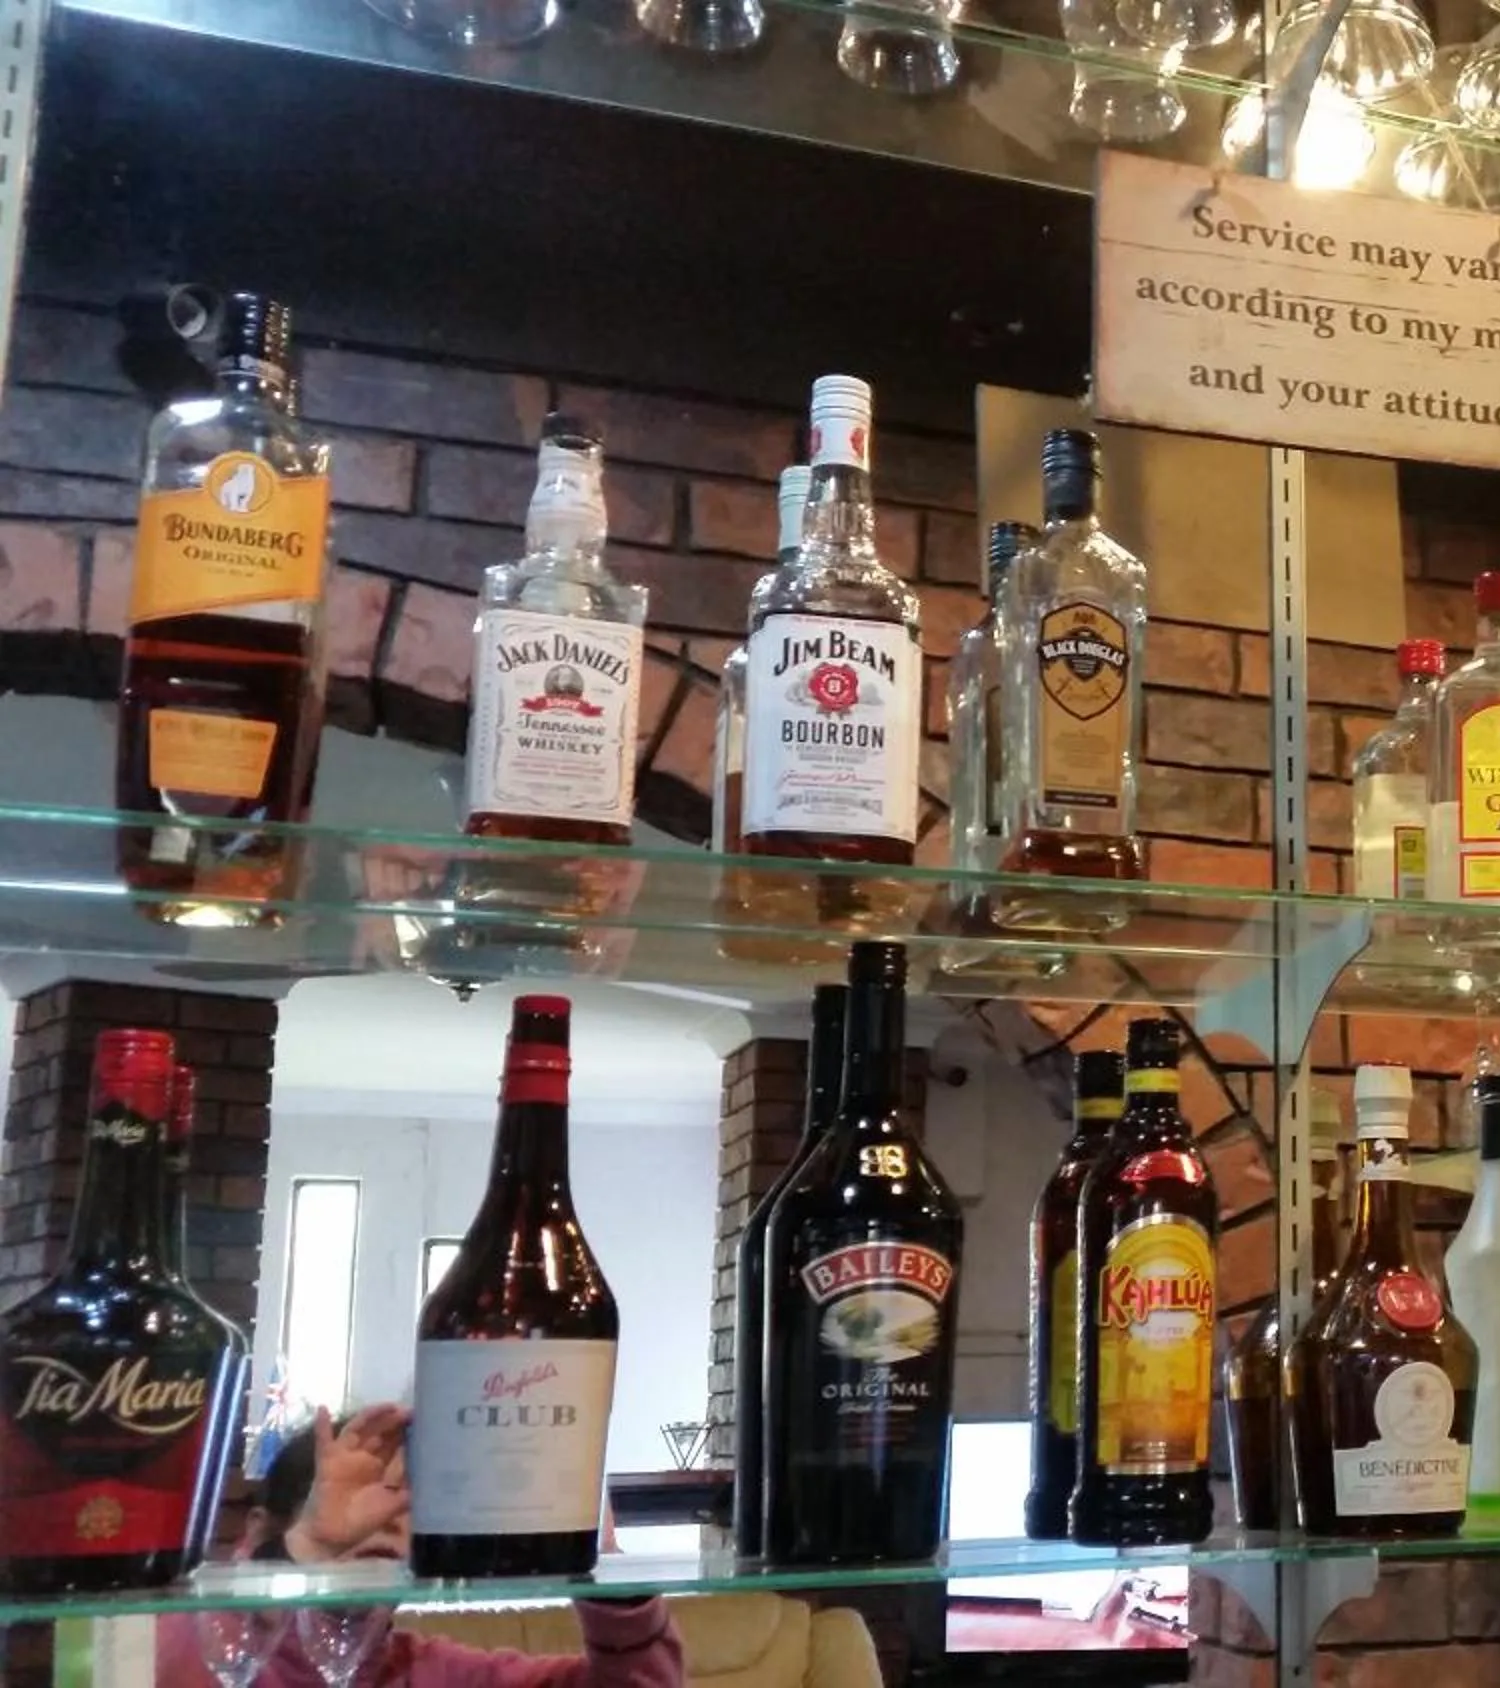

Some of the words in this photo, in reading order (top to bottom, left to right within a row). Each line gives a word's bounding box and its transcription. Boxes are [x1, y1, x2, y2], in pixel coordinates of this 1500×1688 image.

[1192, 203, 1337, 258] Service
[1350, 240, 1433, 283] may
[1135, 276, 1336, 339] according
[1350, 306, 1388, 335] to
[1402, 317, 1460, 356] my
[1189, 364, 1265, 394] and
[1277, 377, 1370, 410] your
[164, 512, 305, 559] BUNDABERG
[182, 545, 283, 571] ORIGINAL
[497, 640, 549, 673] JACK
[773, 637, 823, 677] JIM
[828, 629, 896, 686] BEAM
[517, 735, 605, 756] WHISKEY
[781, 719, 886, 760] BOURBON
[813, 1249, 947, 1290] BAILEYS
[1099, 1264, 1214, 1330] KAHLÚA
[13, 1355, 93, 1421] Tia
[67, 1356, 206, 1435] Maria
[821, 1382, 929, 1399] ORIGINAL
[457, 1404, 577, 1428] CLUB
